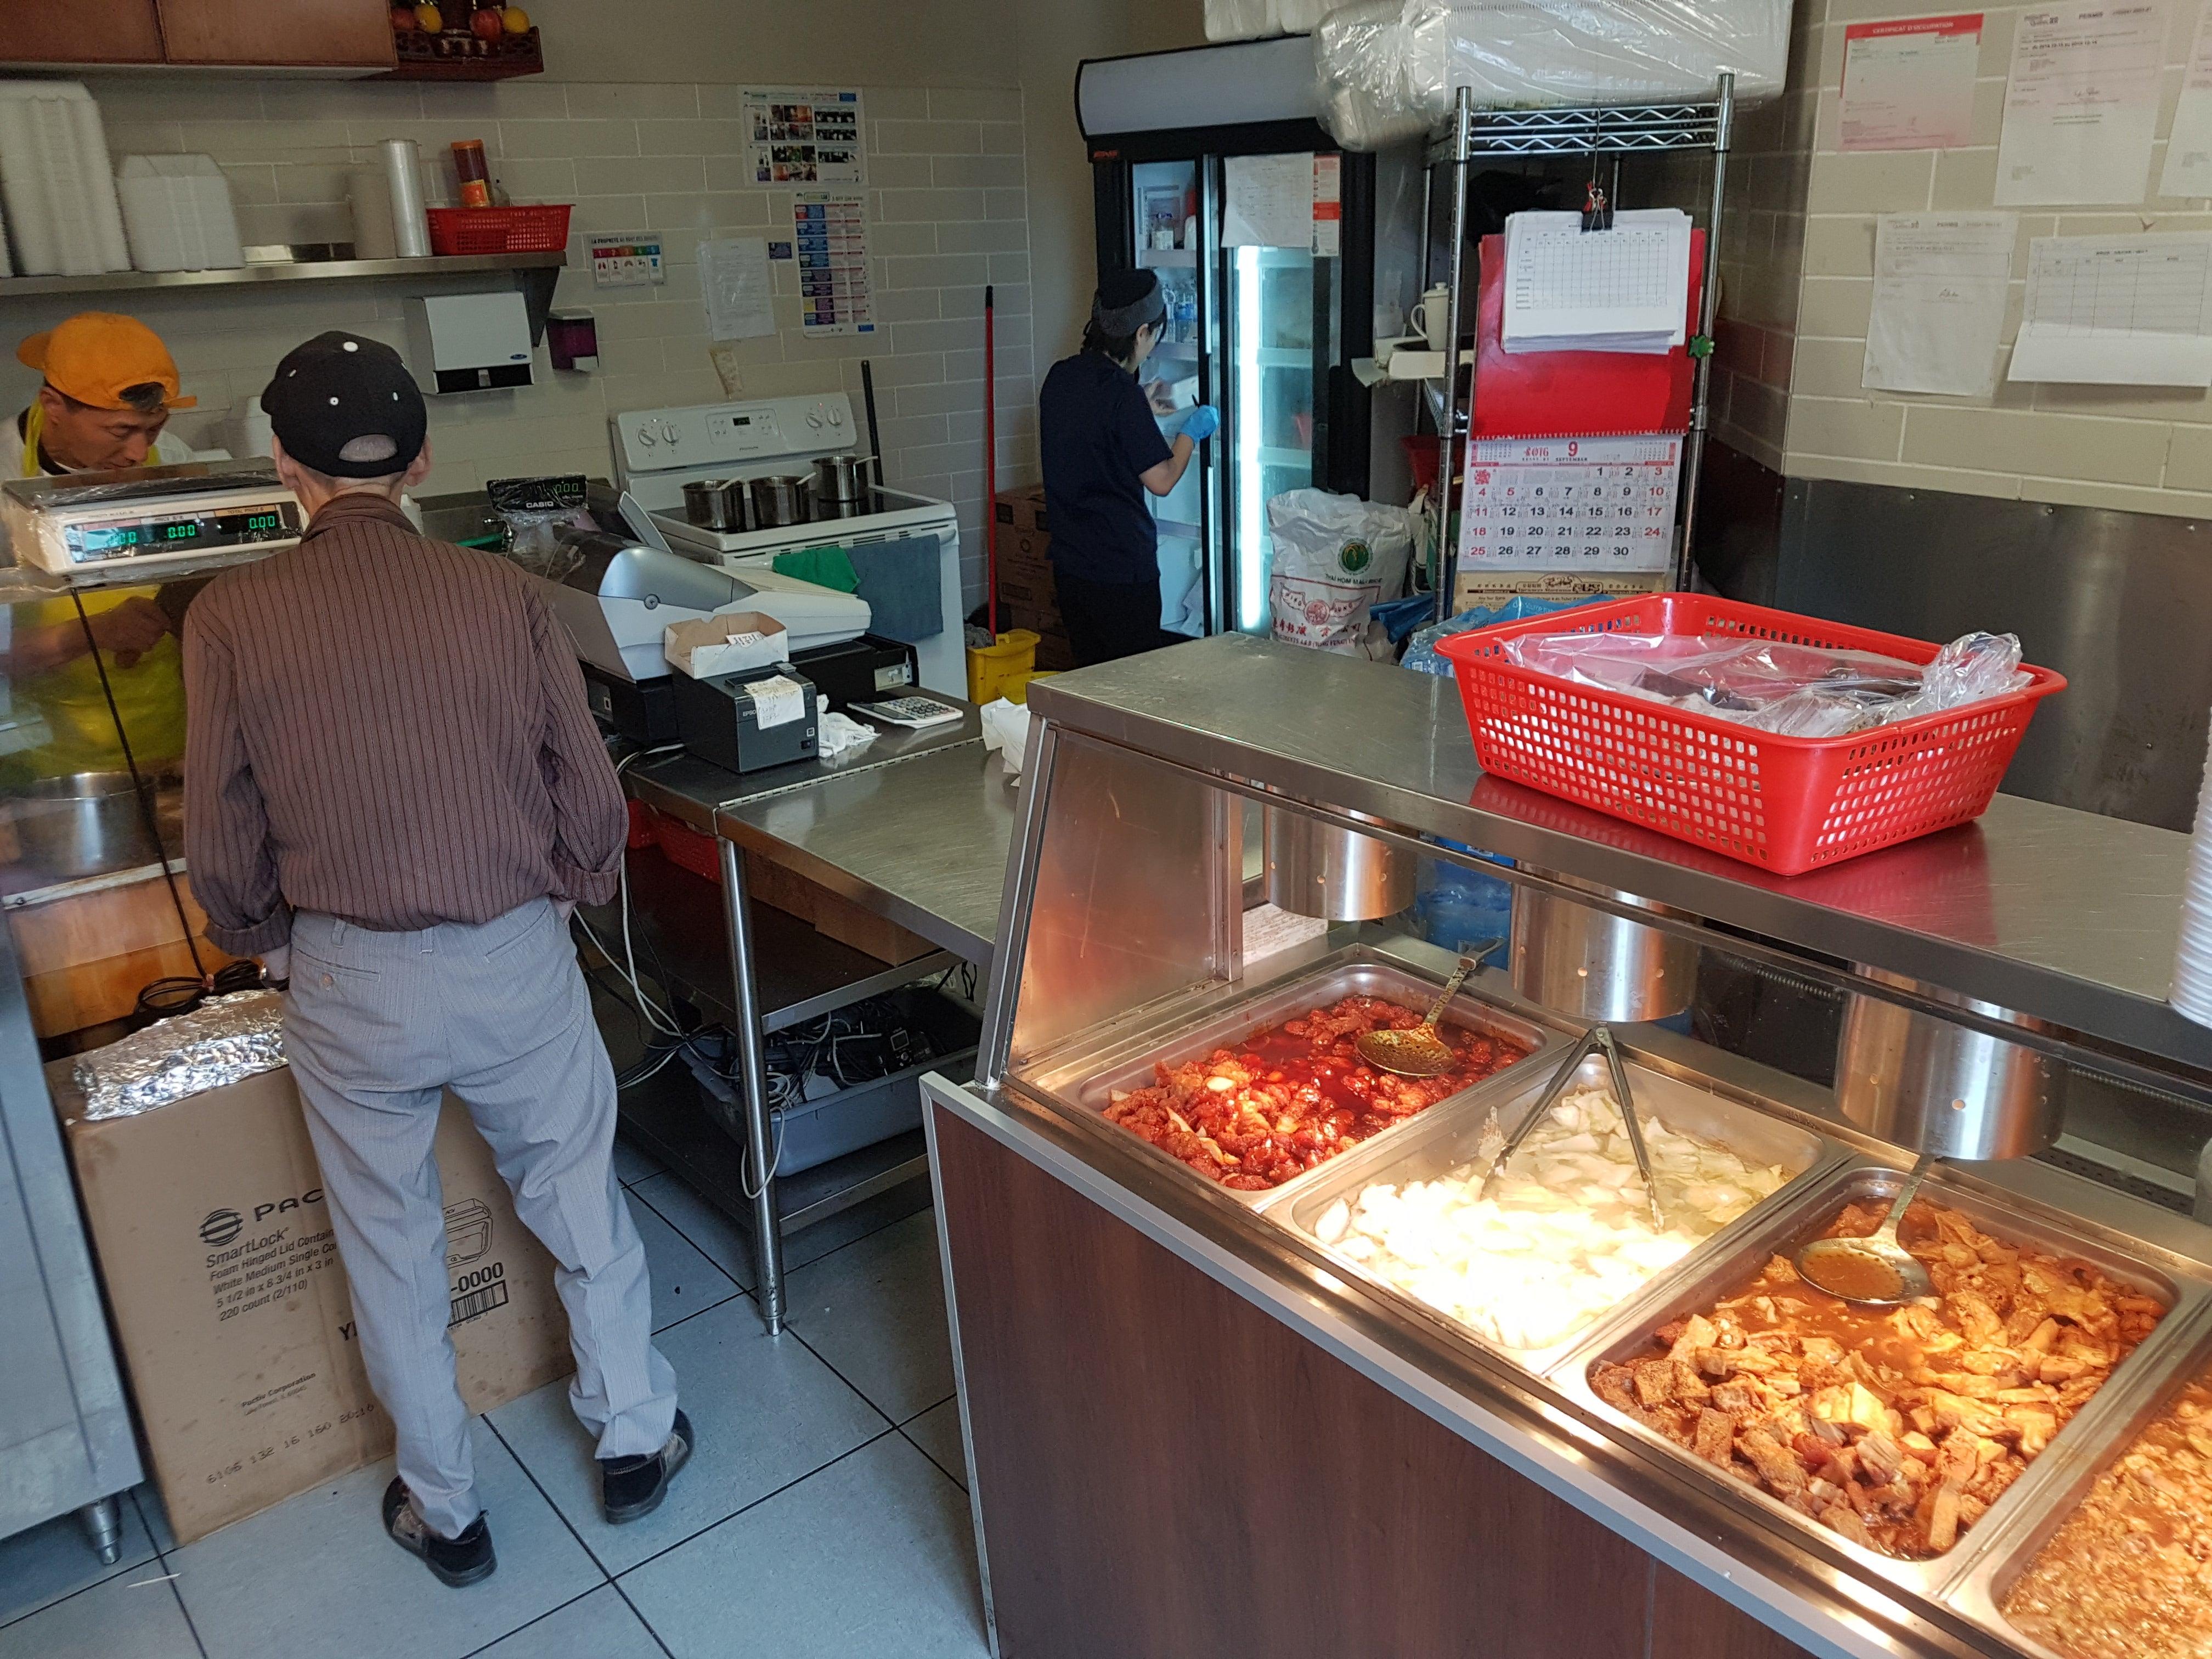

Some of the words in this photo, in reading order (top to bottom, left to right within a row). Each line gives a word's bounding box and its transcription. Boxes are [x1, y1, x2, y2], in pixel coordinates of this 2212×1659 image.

[1568, 441, 1578, 456] 9
[1598, 467, 1603, 476] 1
[1625, 467, 1633, 476] 2
[1655, 467, 1663, 476] 3
[1479, 488, 1486, 496] 4
[1507, 487, 1515, 496] 5
[1536, 487, 1543, 496] 6
[1565, 487, 1573, 495] 7
[1594, 487, 1601, 496] 8
[1623, 487, 1631, 496] 9
[1649, 487, 1664, 496] 10
[1475, 508, 1488, 516] 11
[1503, 507, 1516, 516] 12
[1531, 507, 1544, 516] 13
[1559, 507, 1573, 516] 14
[1589, 507, 1603, 516] 15
[1618, 507, 1632, 516] 16
[1647, 507, 1662, 516] 17
[1472, 528, 1486, 536] 18
[1500, 527, 1514, 535] 19
[1528, 527, 1543, 535] 20
[1585, 527, 1602, 535] 22
[1615, 527, 1630, 535] 23
[1645, 527, 1660, 536] 24
[1470, 547, 1486, 555] 25
[1498, 546, 1513, 555] 26
[1526, 546, 1542, 555] 27
[1584, 547, 1599, 555] 29
[1613, 547, 1629, 555] 30
[210, 1263, 239, 1282] Foam
[241, 1249, 277, 1269] Hinged
[280, 1240, 295, 1255] Lid
[213, 1276, 242, 1295] White
[246, 1260, 286, 1283] Medium
[289, 1248, 319, 1265] Single
[217, 1298, 223, 1308] 5
[227, 1289, 243, 1303] 1/2
[246, 1286, 255, 1296] in
[258, 1283, 264, 1291] x
[267, 1278, 273, 1288] 8
[276, 1271, 292, 1285] 3/4
[296, 1267, 304, 1277] in
[306, 1264, 312, 1273] x
[315, 1260, 321, 1269] 3
[325, 1257, 334, 1267] in
[220, 1306, 240, 1322] 220
[242, 1295, 270, 1312] count
[273, 1279, 308, 1301] (2/110)
[268, 1373, 316, 1397] Corporation
